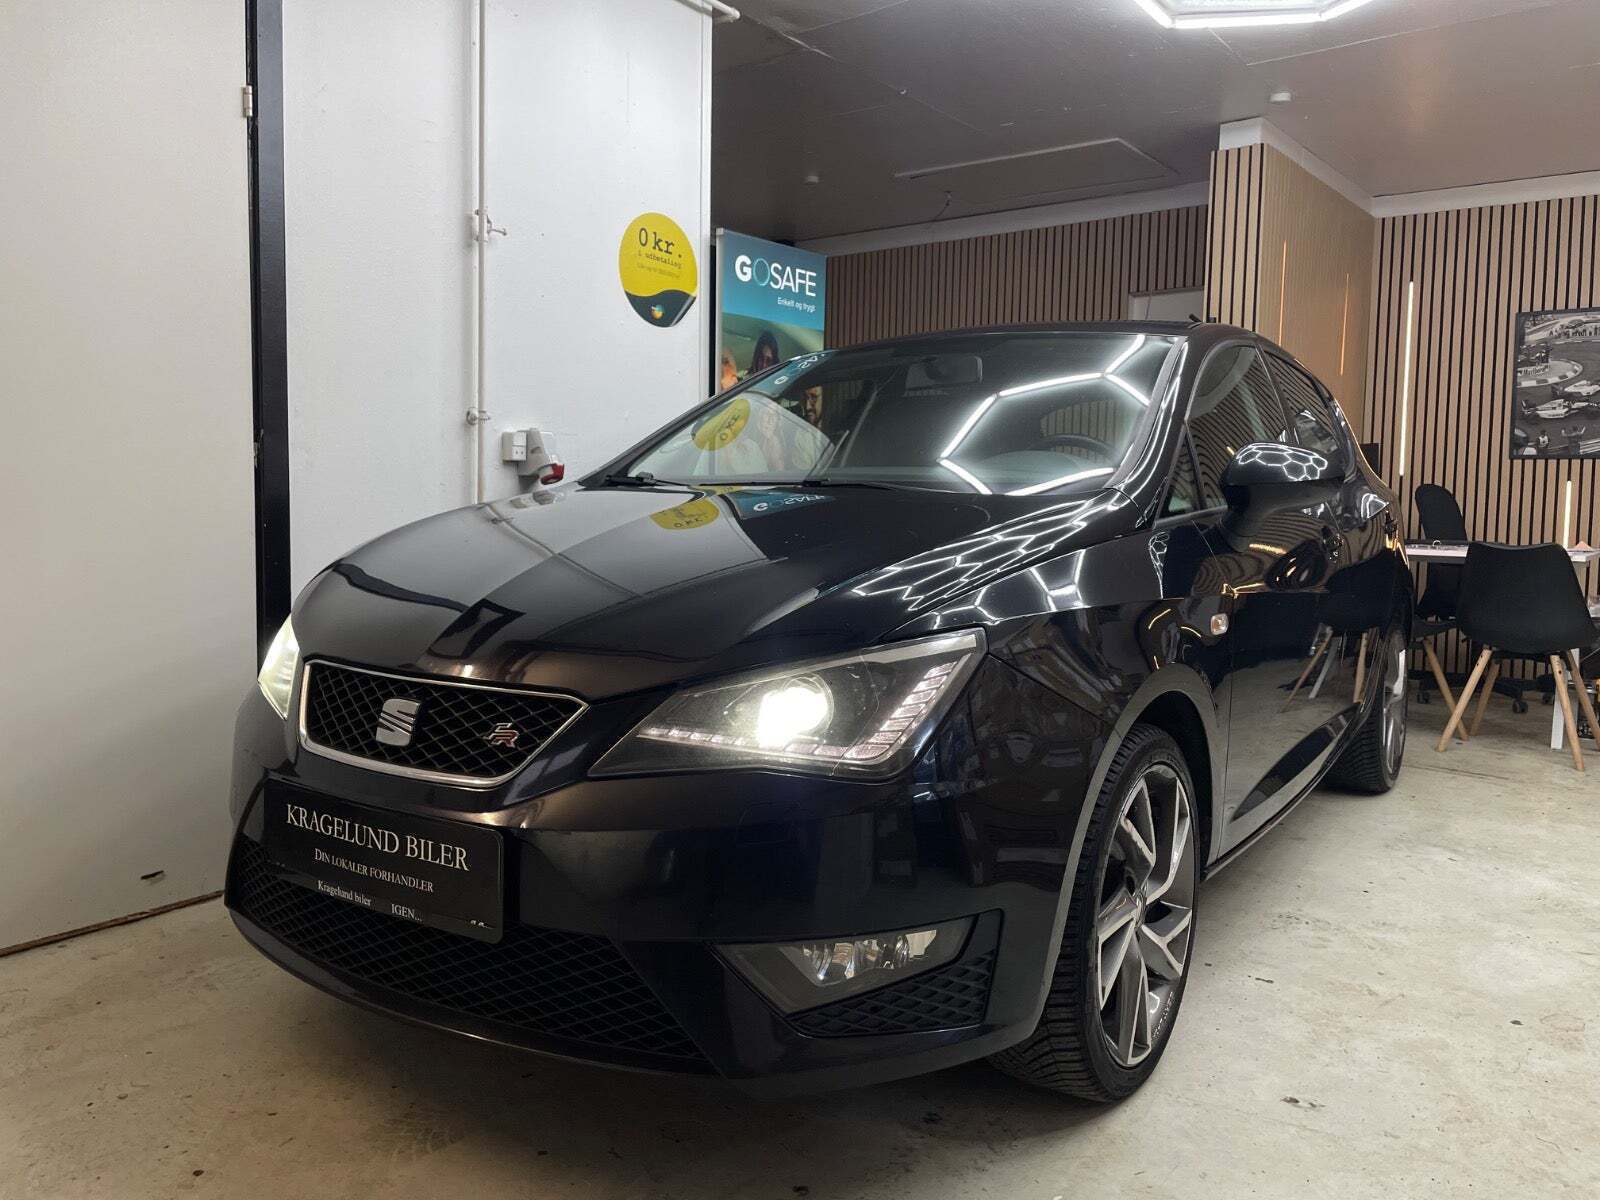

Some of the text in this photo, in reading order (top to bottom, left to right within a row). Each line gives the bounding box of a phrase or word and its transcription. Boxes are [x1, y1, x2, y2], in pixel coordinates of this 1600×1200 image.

[639, 227, 682, 258] 0 kr.
[735, 254, 817, 297] GOSAFE
[286, 804, 470, 872] KRAGELUND BILER
[314, 848, 434, 893] DIN LOKALER FORHANDLER
[317, 880, 353, 900] Kragelund
